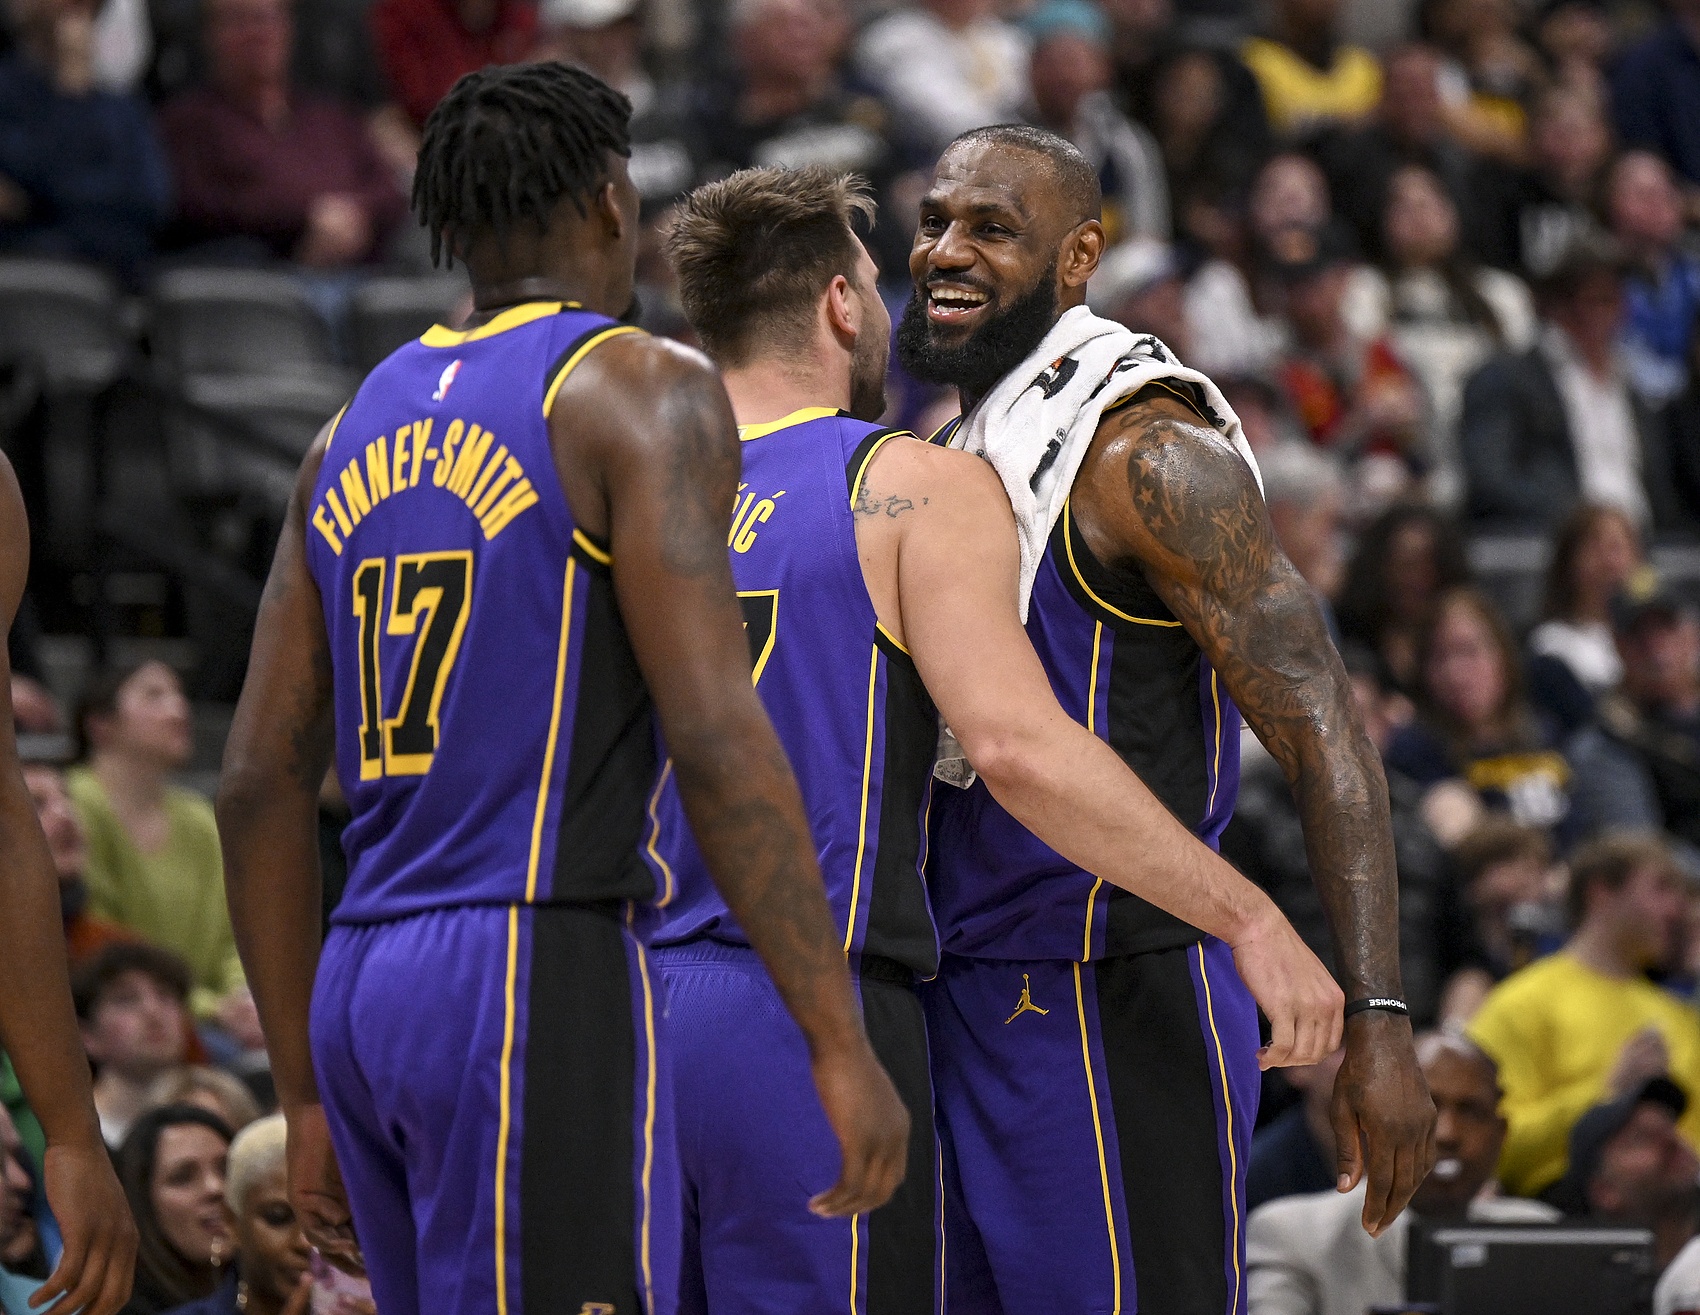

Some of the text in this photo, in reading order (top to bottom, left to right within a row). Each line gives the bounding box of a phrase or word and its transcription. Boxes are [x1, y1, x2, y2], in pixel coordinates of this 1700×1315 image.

[312, 418, 540, 556] FINNEY-SMITH
[727, 482, 786, 553] IĆ
[352, 549, 474, 781] 17
